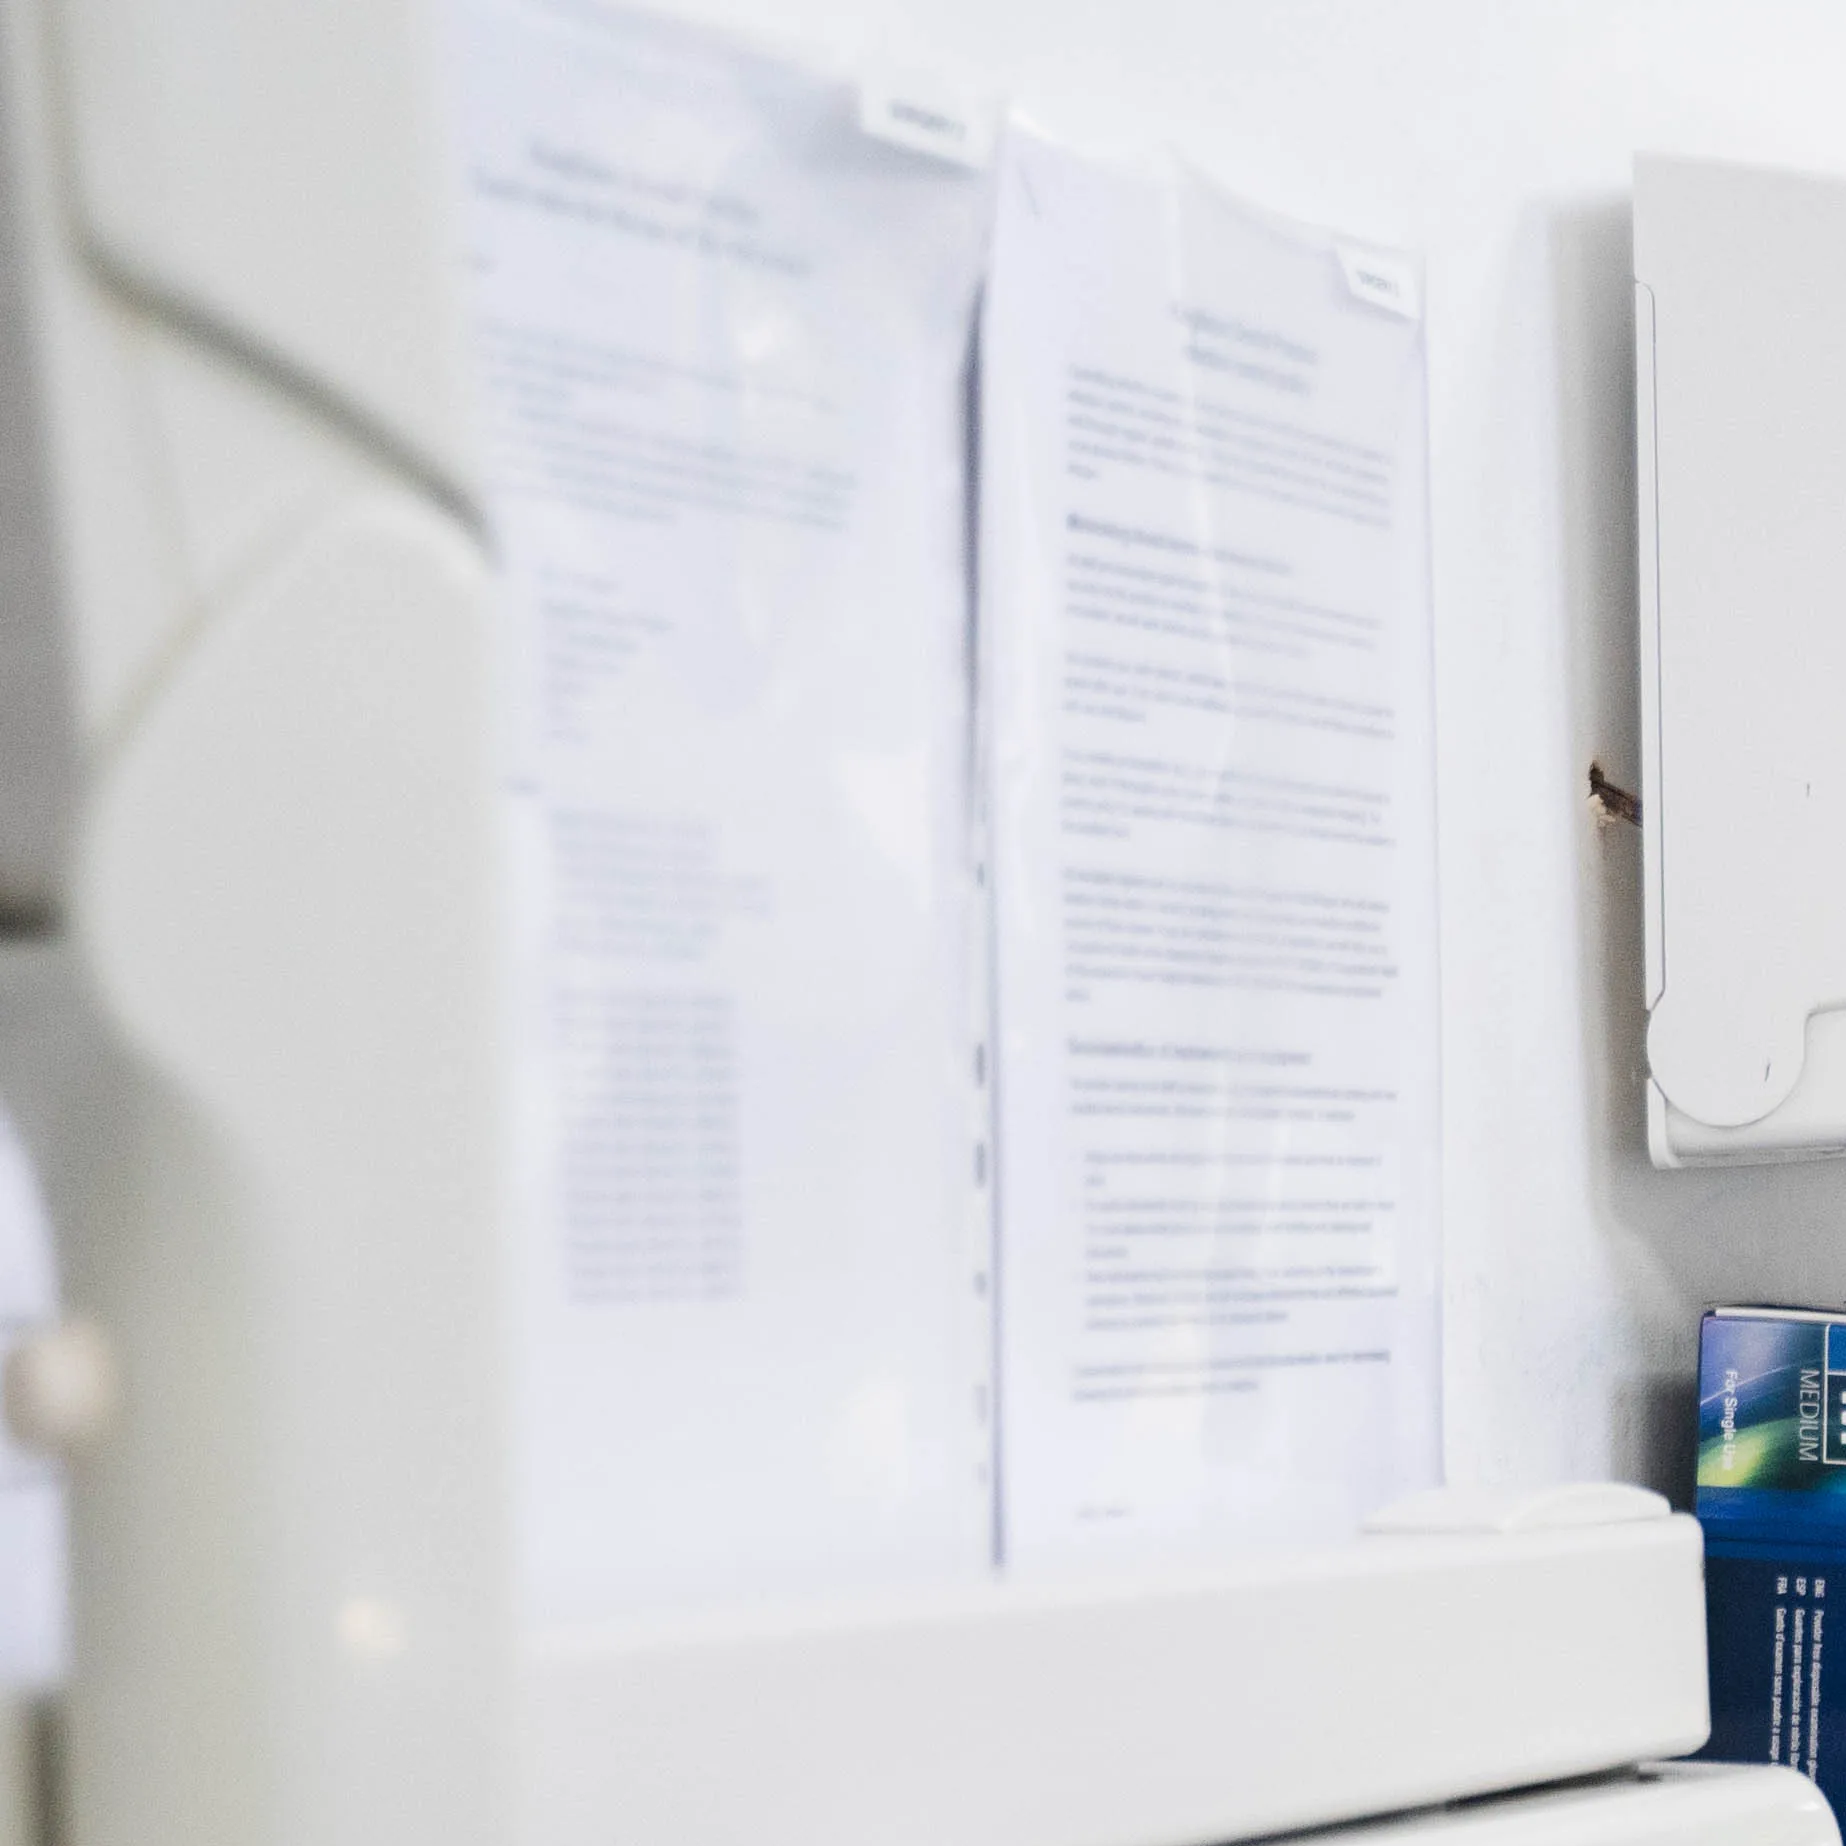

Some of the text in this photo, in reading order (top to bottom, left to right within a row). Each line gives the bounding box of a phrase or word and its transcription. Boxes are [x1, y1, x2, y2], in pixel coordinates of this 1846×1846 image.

[1720, 1370, 1739, 1470] For Single Use
[1798, 1368, 1820, 1462] MEDIUM
[1812, 1609, 1824, 1642] Powder
